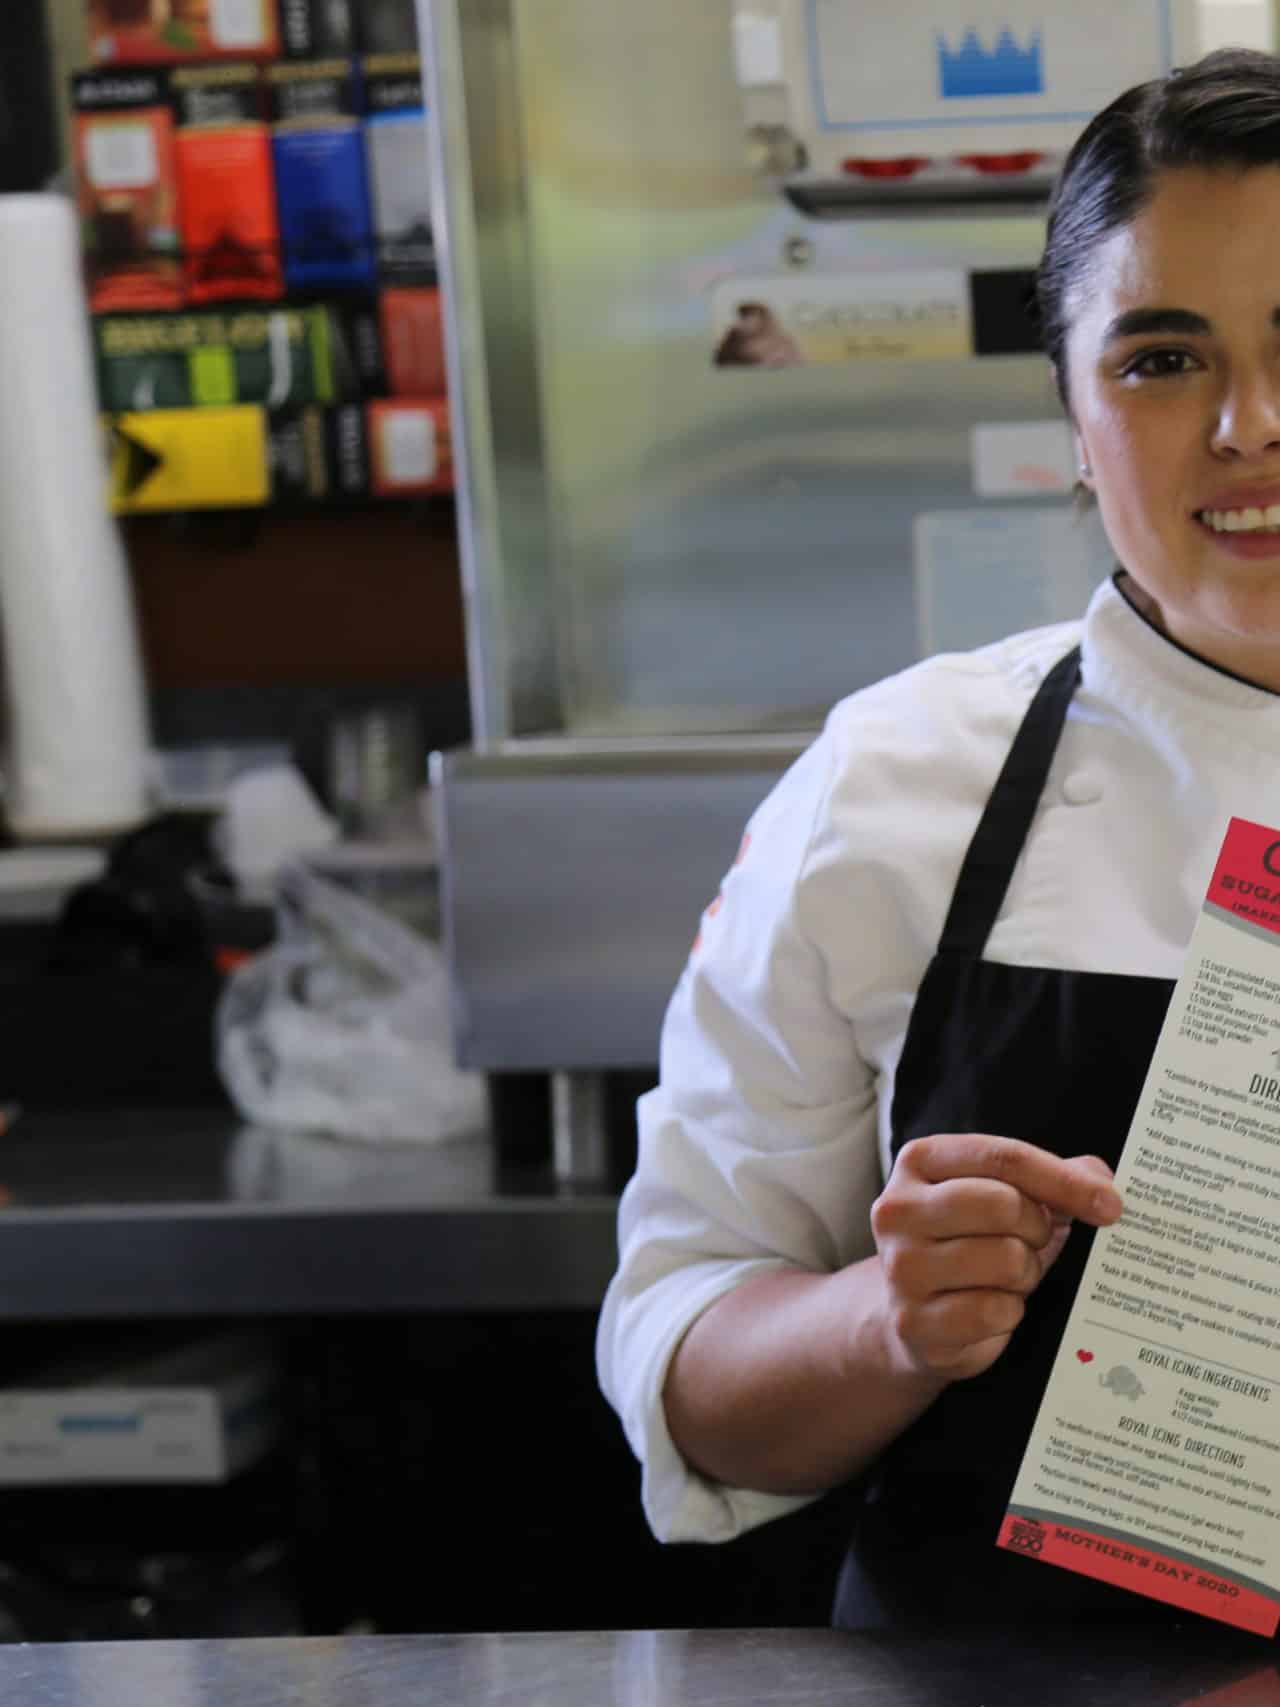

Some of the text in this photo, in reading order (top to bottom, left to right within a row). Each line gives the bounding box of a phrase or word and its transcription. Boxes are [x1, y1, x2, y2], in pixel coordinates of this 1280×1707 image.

[1137, 1347, 1271, 1401] ROYAL ICING INGREDIENTS
[1117, 1415, 1247, 1469] ROYAL ICING DIRECTIONS
[1055, 1527, 1149, 1568] MOTHER'S
[1153, 1560, 1194, 1582] DAY
[1197, 1576, 1240, 1597] 2020
